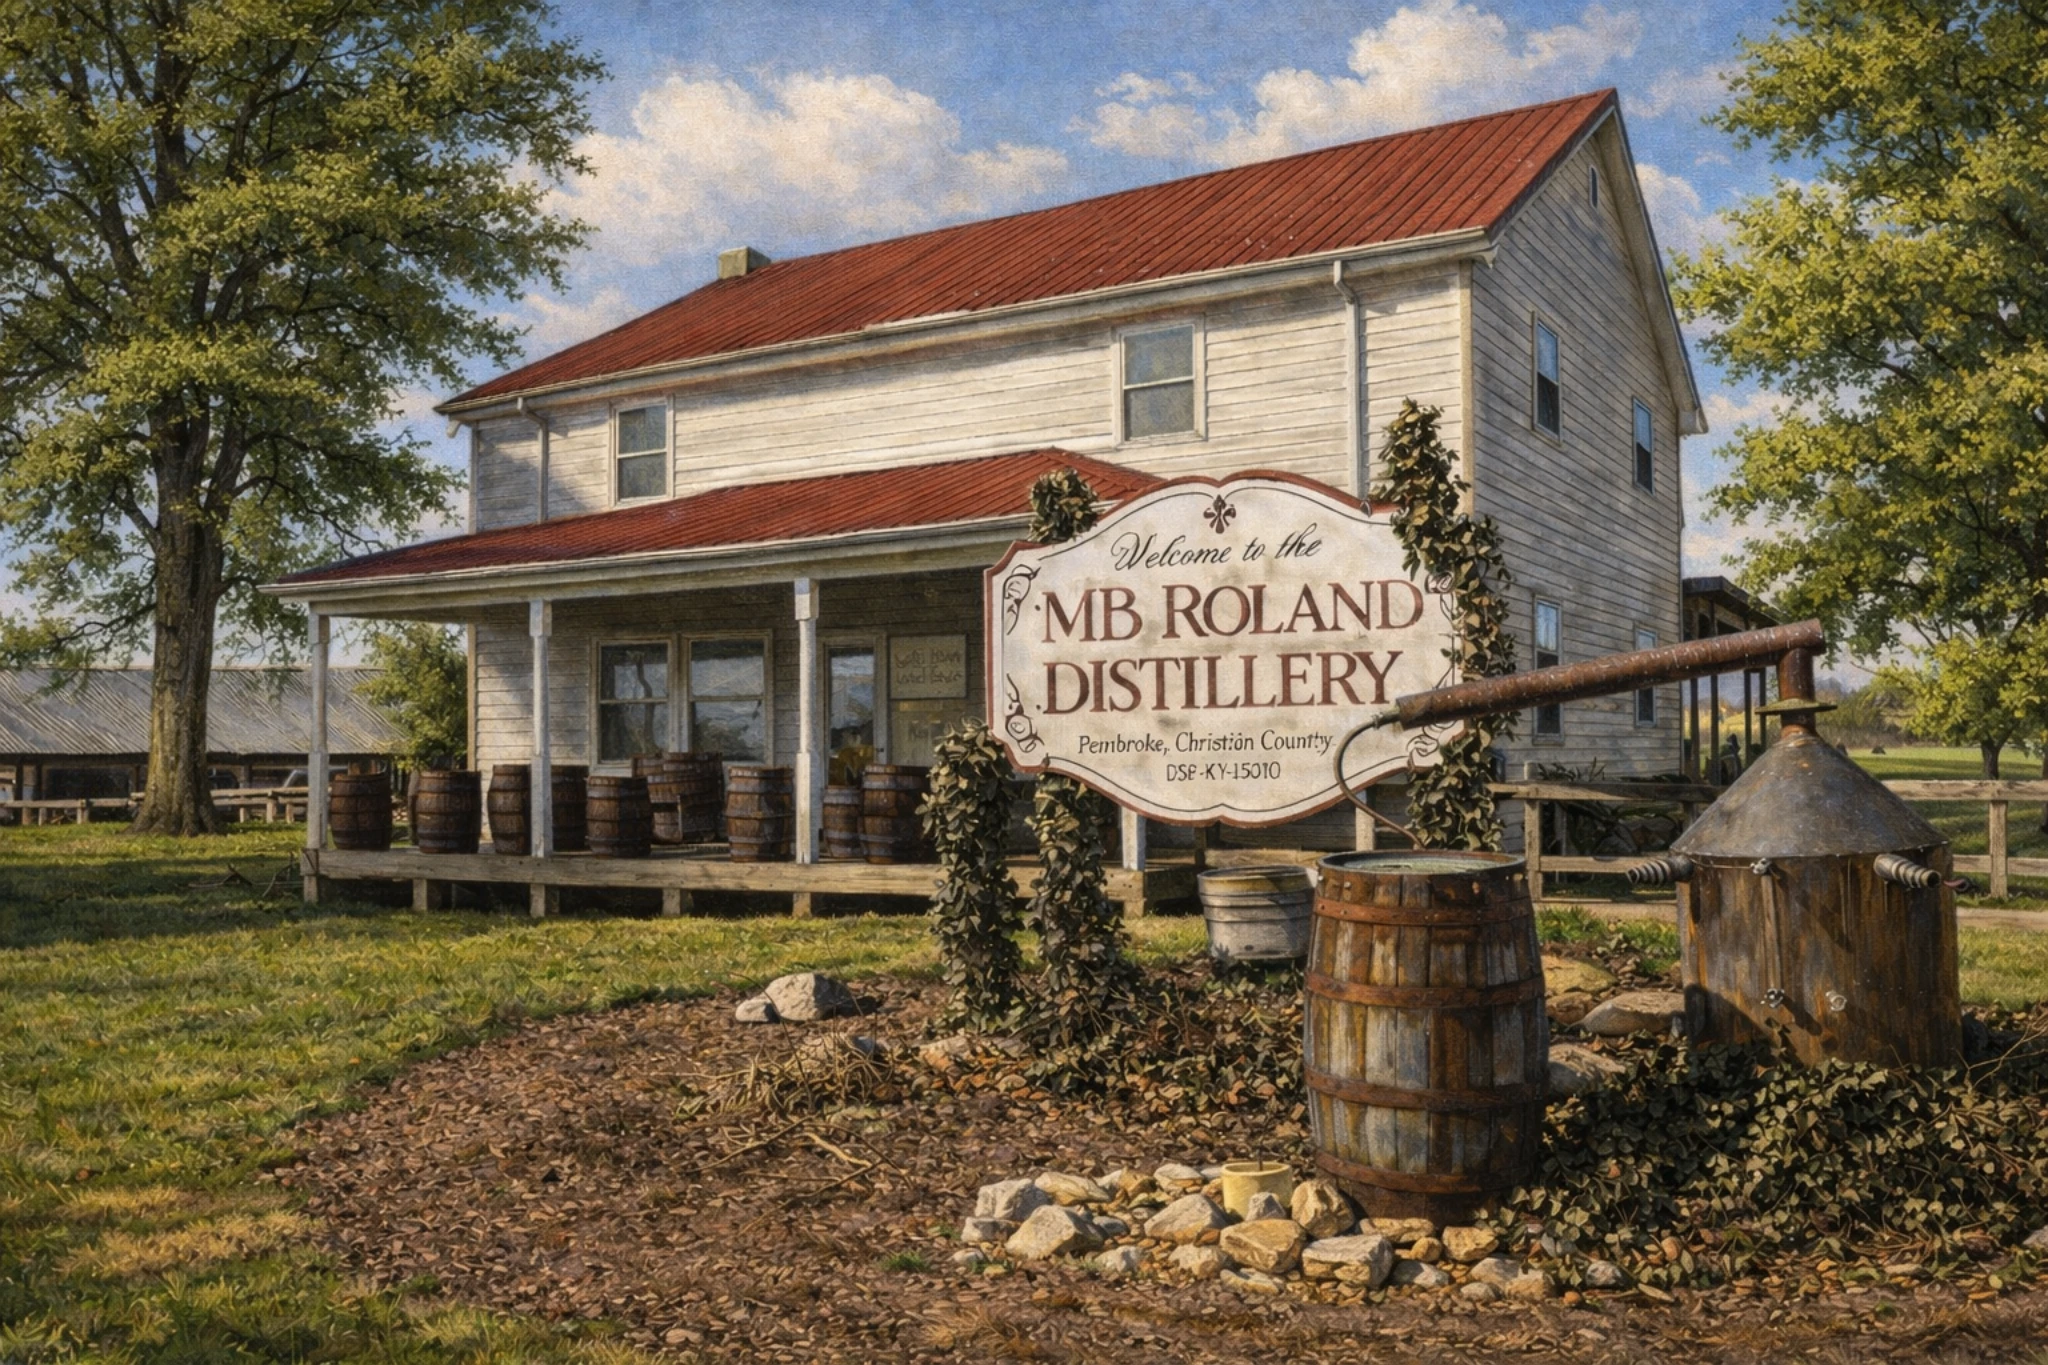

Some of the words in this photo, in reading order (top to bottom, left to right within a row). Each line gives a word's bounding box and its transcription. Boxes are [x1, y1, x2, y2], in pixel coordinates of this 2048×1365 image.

[1111, 531, 1231, 571] Welcome
[1242, 537, 1266, 562] to
[1274, 522, 1323, 559] the
[1042, 586, 1143, 643] MB
[1161, 579, 1424, 640] ROLAND
[1042, 650, 1404, 715] DISTILLERY
